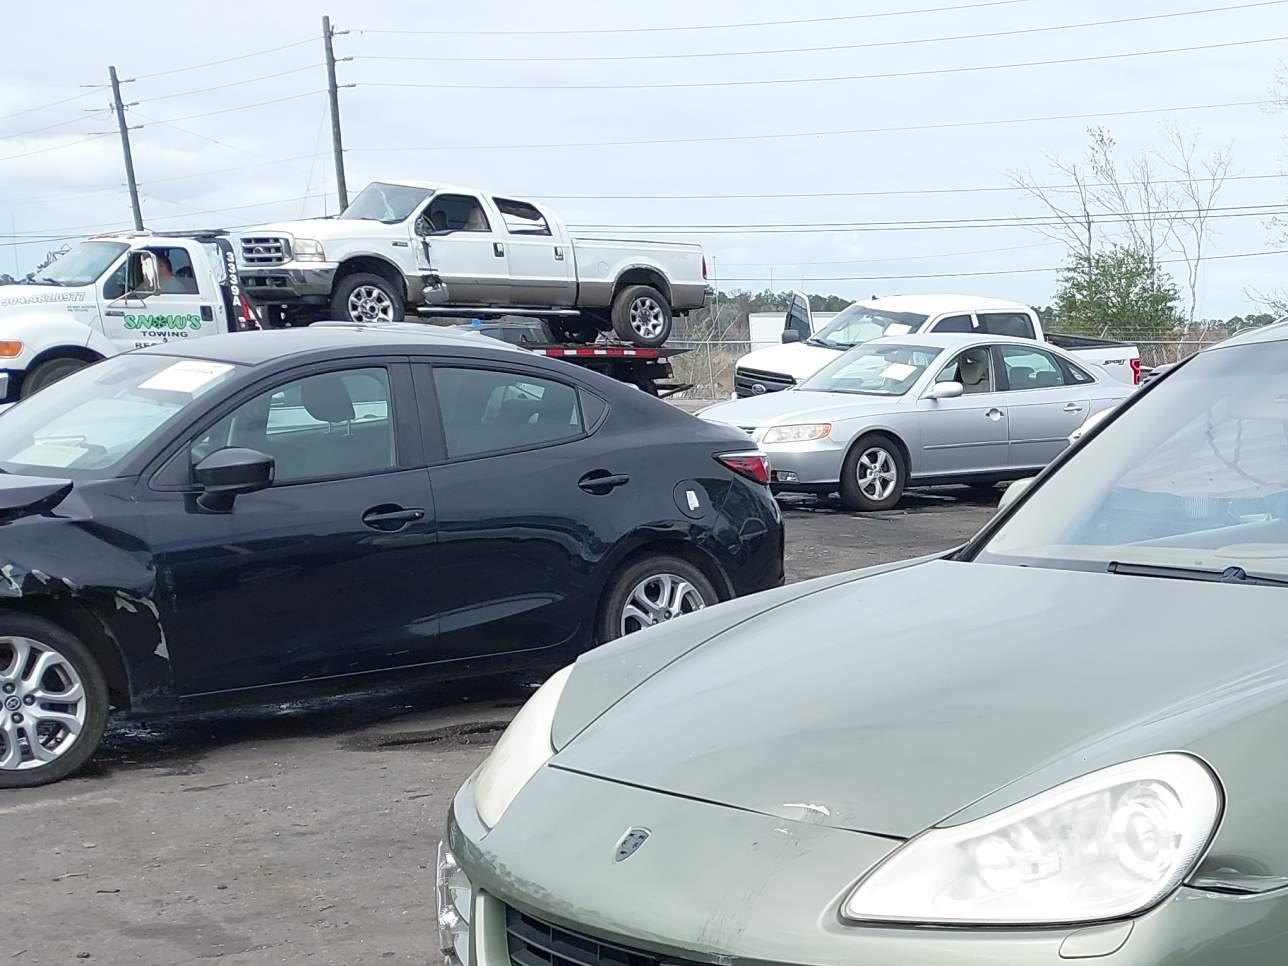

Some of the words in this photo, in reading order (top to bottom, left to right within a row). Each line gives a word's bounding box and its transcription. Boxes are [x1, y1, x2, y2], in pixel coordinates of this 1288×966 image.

[227, 252, 243, 306] 3339A
[124, 314, 201, 331] SNOW'S
[140, 330, 189, 338] TOWING
